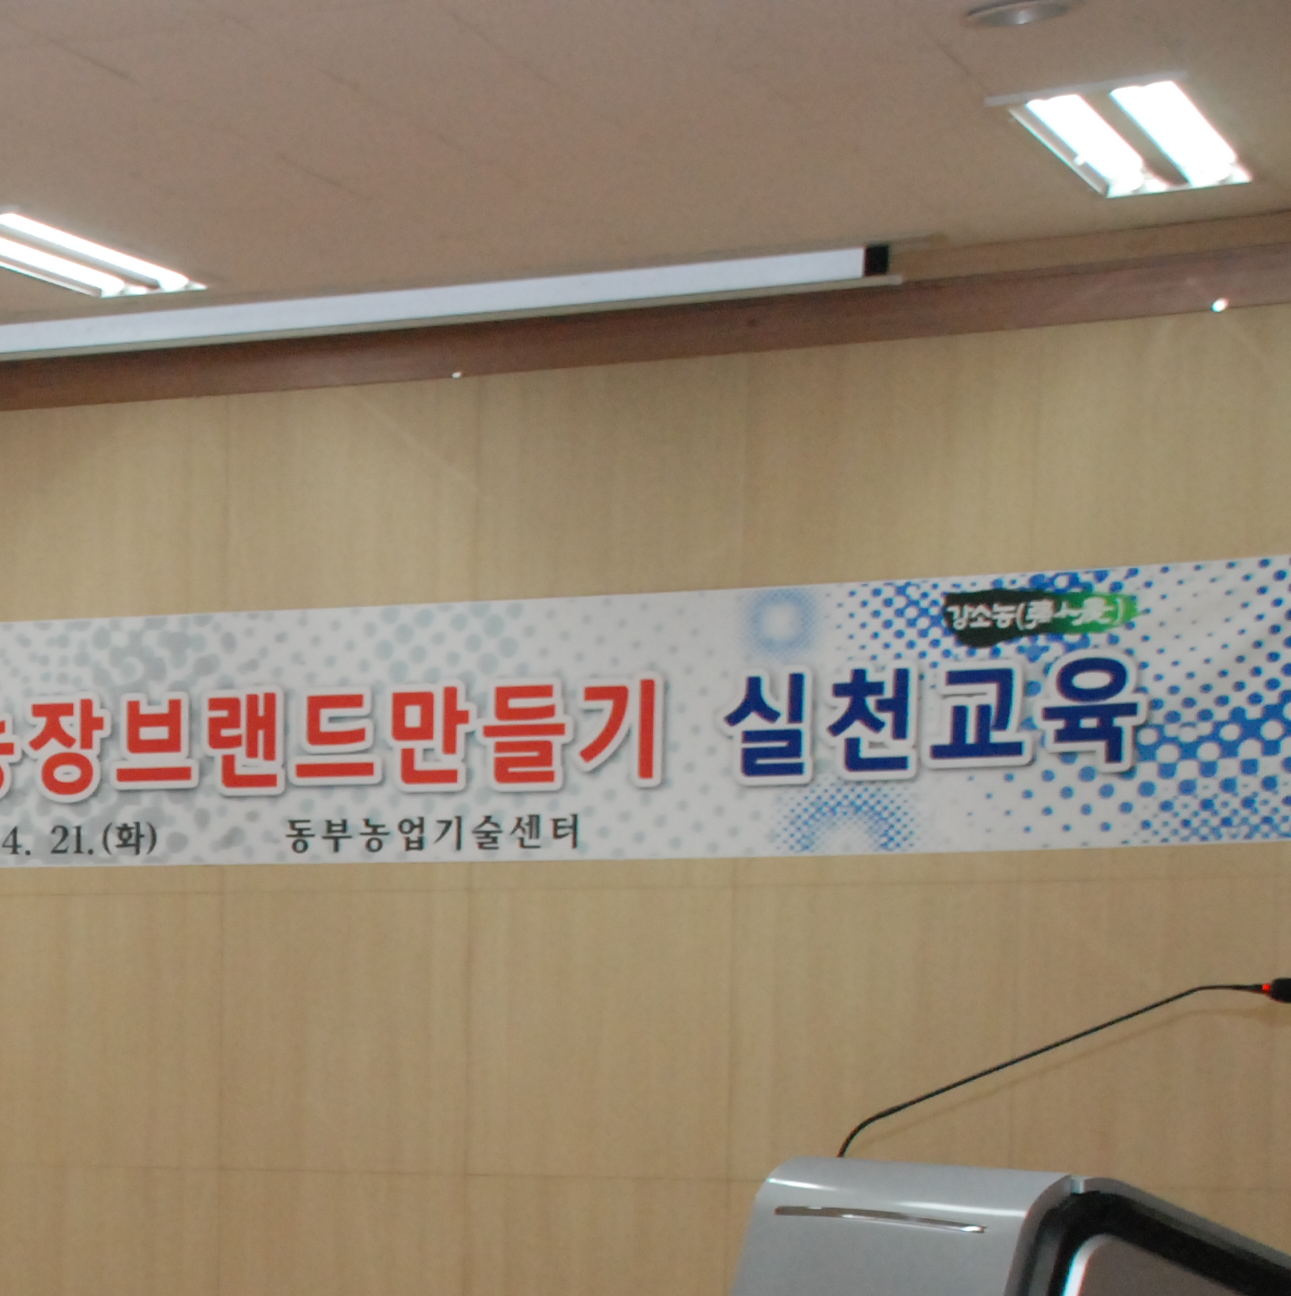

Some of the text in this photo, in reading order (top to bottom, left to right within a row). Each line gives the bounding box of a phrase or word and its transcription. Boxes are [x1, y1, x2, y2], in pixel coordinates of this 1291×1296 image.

[724, 658, 1138, 778] 실천교육
[1, 826, 31, 857] 4.
[50, 820, 158, 857] 21.(화)
[284, 812, 580, 854] 동부농업기술센터
